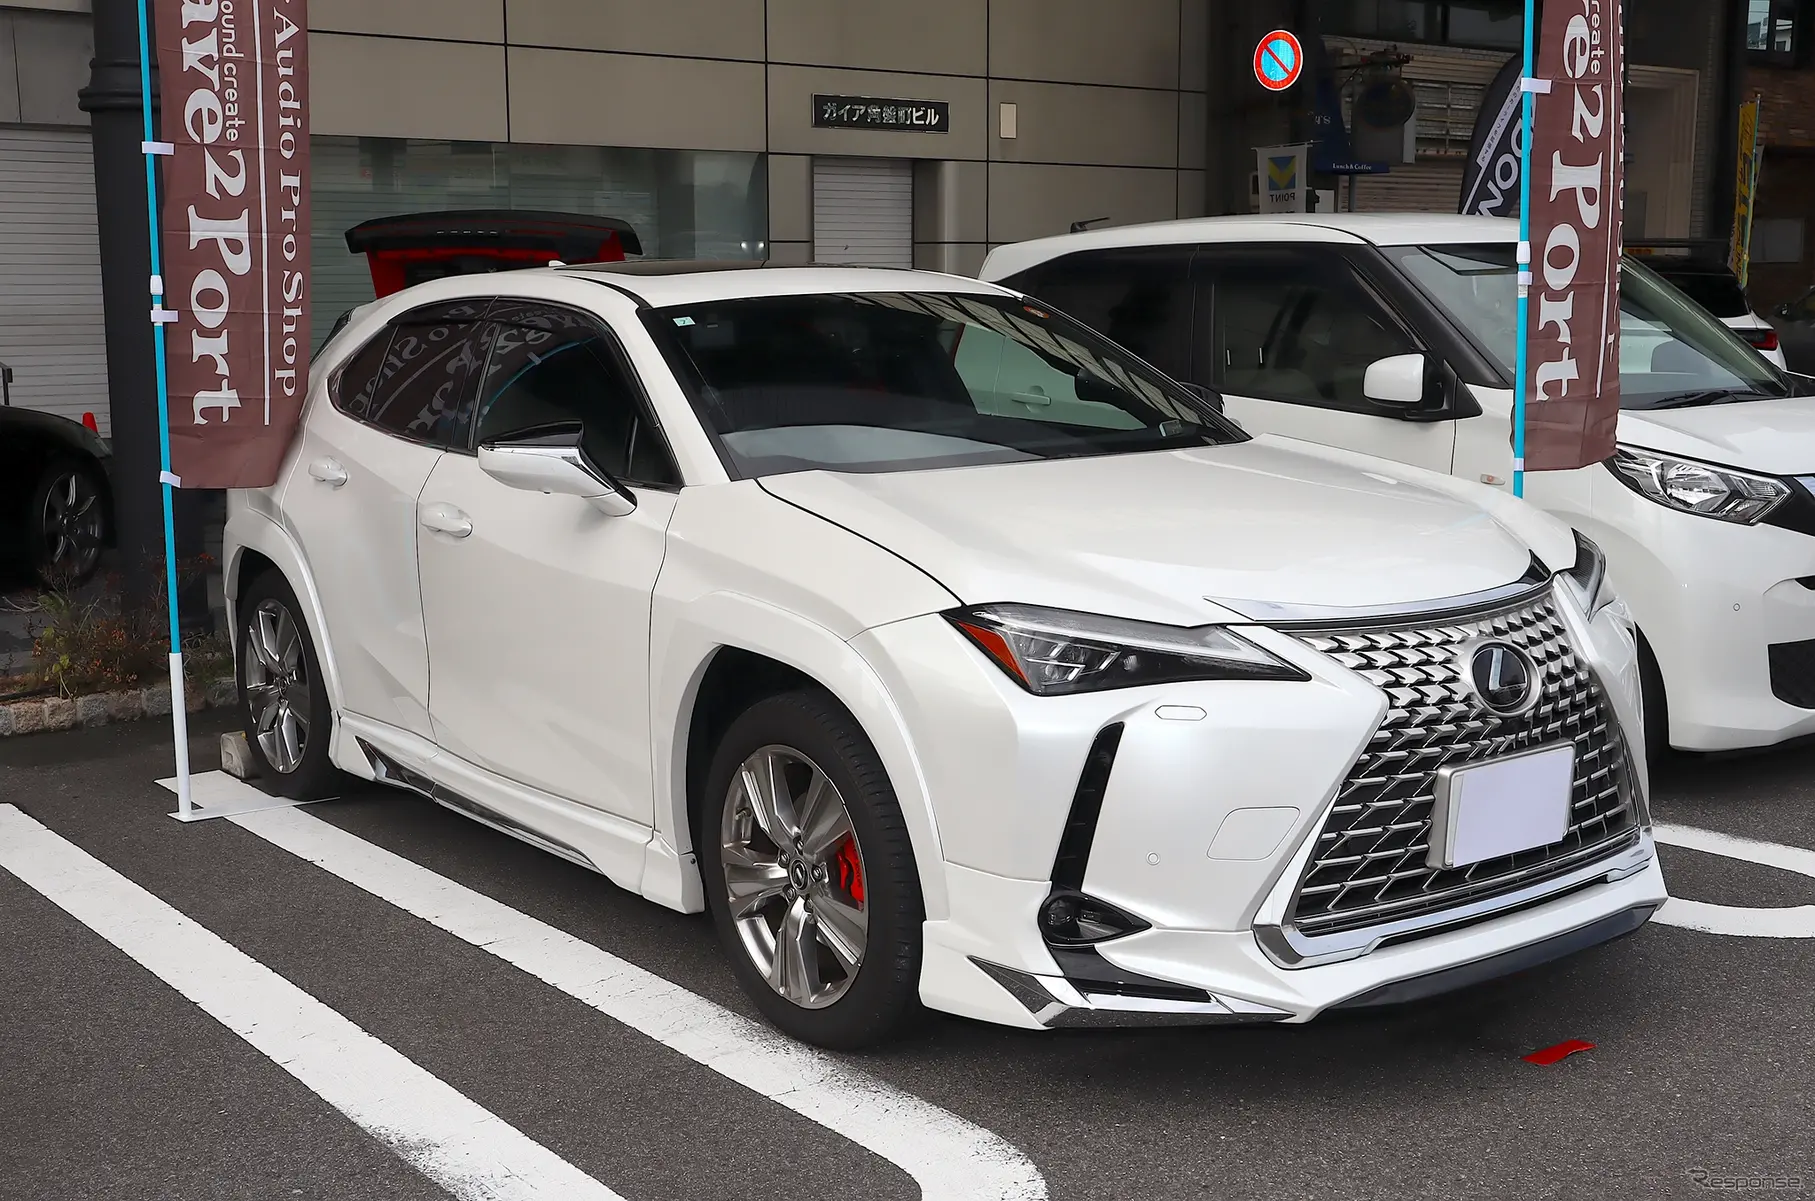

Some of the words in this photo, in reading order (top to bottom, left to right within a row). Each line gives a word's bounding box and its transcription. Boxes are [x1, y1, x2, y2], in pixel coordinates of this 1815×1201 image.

[273, 6, 302, 160] Audio
[1590, 0, 1605, 75] reate
[223, 62, 246, 142] create
[1536, 0, 1604, 401] e2Port
[274, 270, 304, 397] Shop
